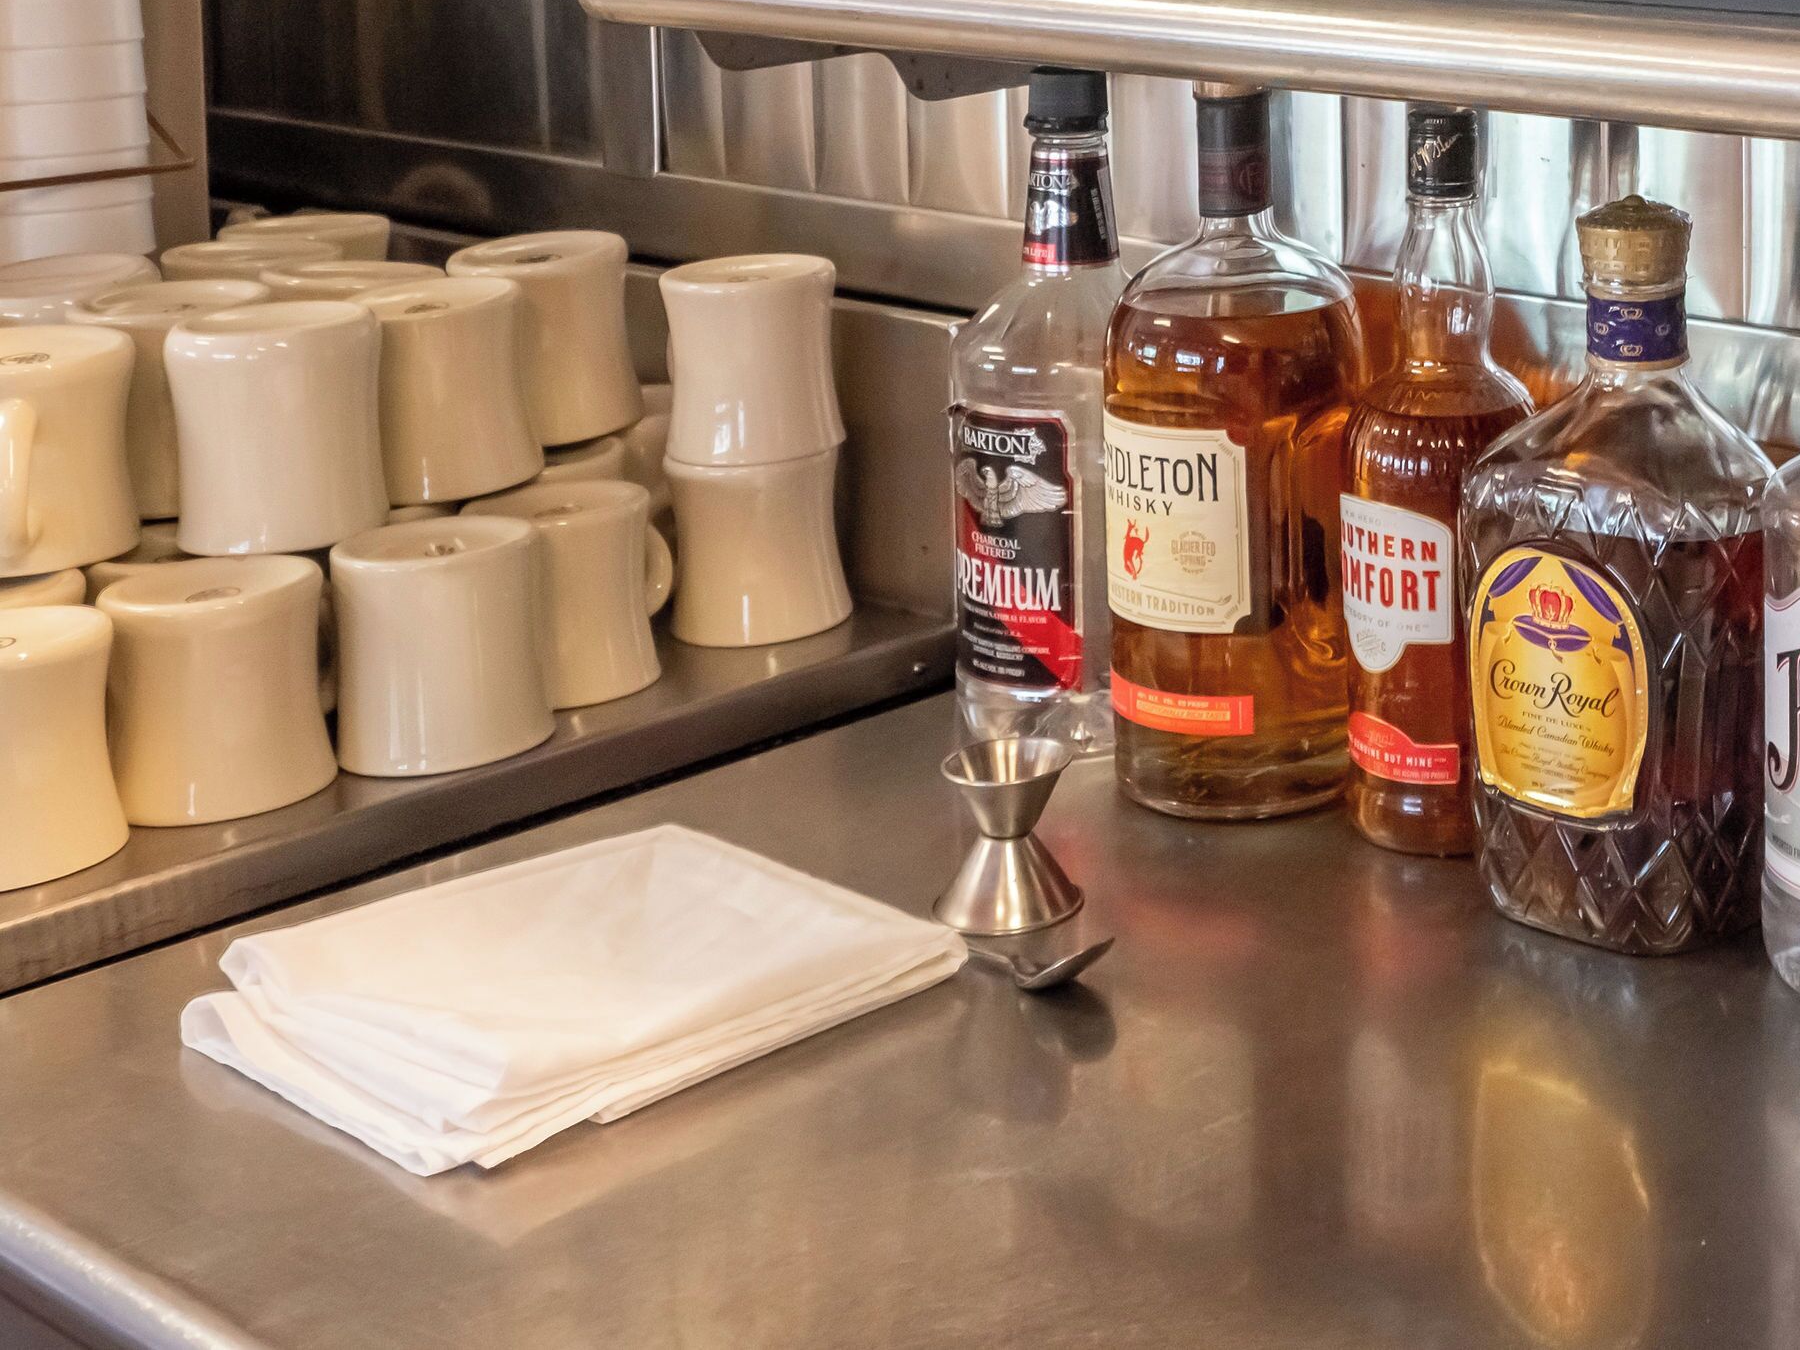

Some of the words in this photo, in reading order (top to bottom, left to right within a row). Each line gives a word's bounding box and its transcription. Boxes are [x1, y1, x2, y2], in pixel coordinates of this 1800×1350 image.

[1030, 174, 1064, 189] RTON
[964, 426, 1026, 454] BARTON
[1104, 440, 1219, 502] NDLETON
[1107, 486, 1173, 516] WHISKY
[971, 531, 1021, 550] CHARCOAL
[975, 544, 1016, 560] FILTERED
[1342, 519, 1439, 563] OUTHERN
[957, 548, 1062, 611] PREMIUM
[1342, 551, 1441, 612] OMFORT
[1145, 596, 1216, 616] TRADITION
[1490, 659, 1547, 700] Crown
[1533, 672, 1620, 718] Royal
[1522, 710, 1543, 721] FINE
[1546, 716, 1557, 724] DE
[1498, 714, 1535, 735] Blended
[1536, 727, 1578, 746] Canadian
[1579, 735, 1615, 757] Whisky
[1384, 752, 1402, 765] BUT
[1406, 756, 1433, 768] MINE
